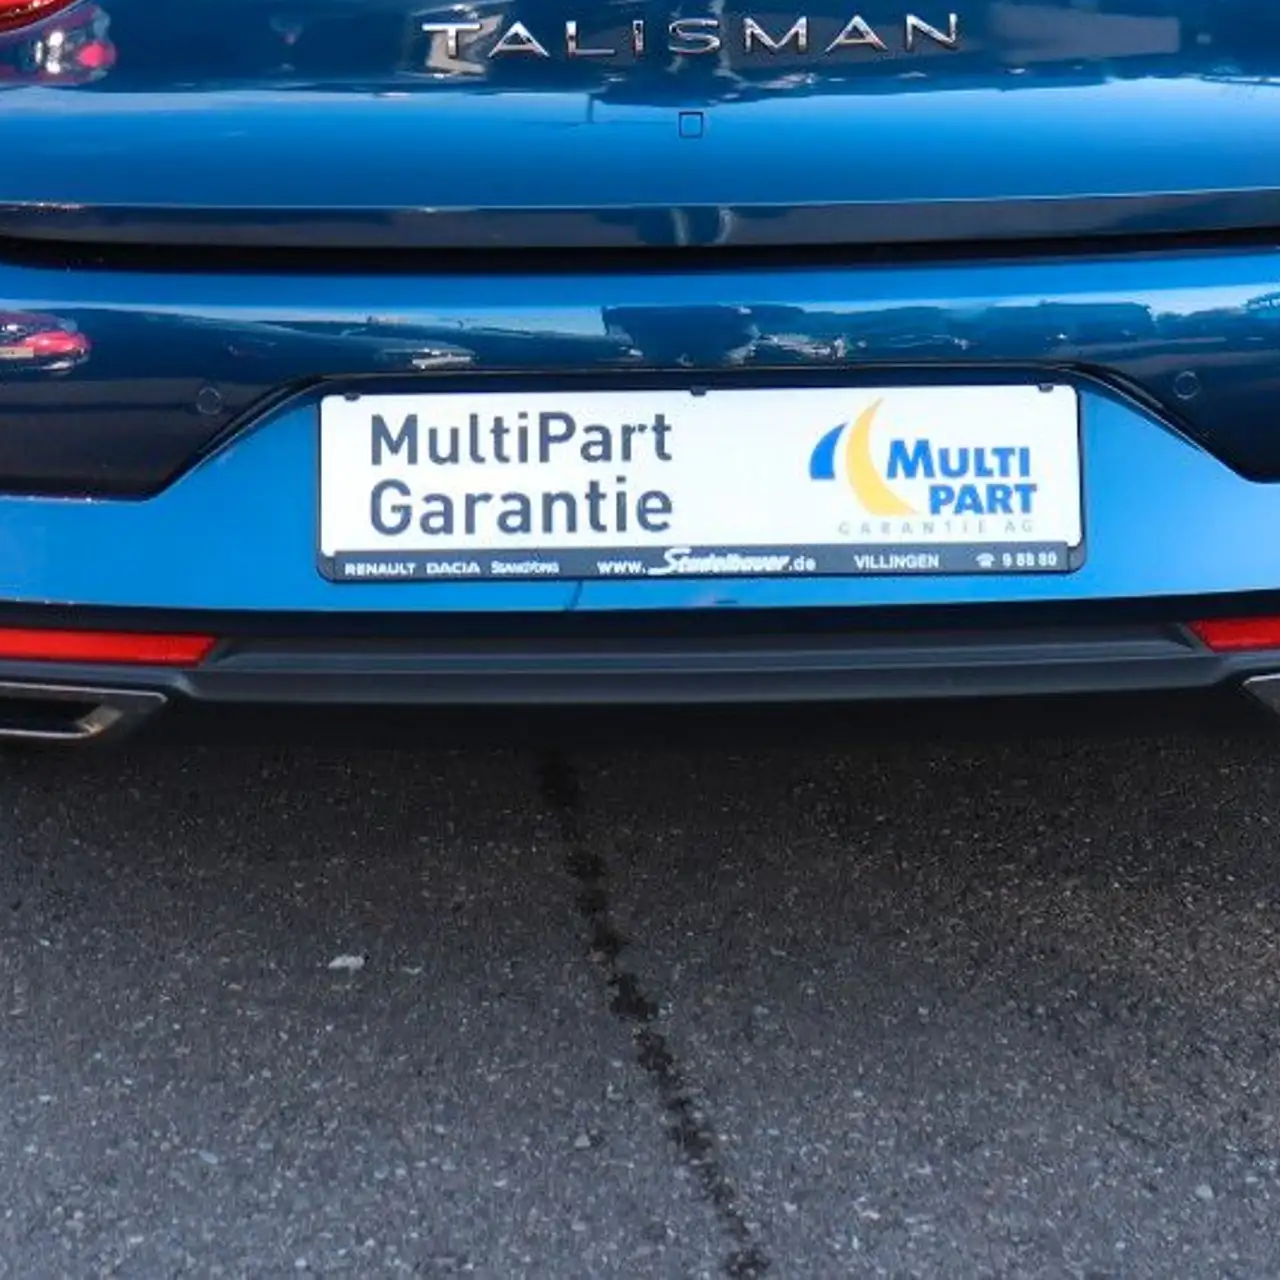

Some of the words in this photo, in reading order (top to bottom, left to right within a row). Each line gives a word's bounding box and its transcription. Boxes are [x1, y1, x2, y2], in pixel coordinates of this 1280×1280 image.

[422, 12, 958, 60] TALISMAN
[370, 411, 673, 465] MultiPart
[886, 439, 1030, 479] MULTI
[370, 475, 673, 535] Garantie
[928, 483, 1038, 515] PART
[837, 520, 987, 536] GARANTIE
[1004, 519, 1034, 533] AG
[344, 561, 417, 576] RENAULT
[426, 561, 481, 575] DACIA
[853, 553, 940, 570] VILLINGEN
